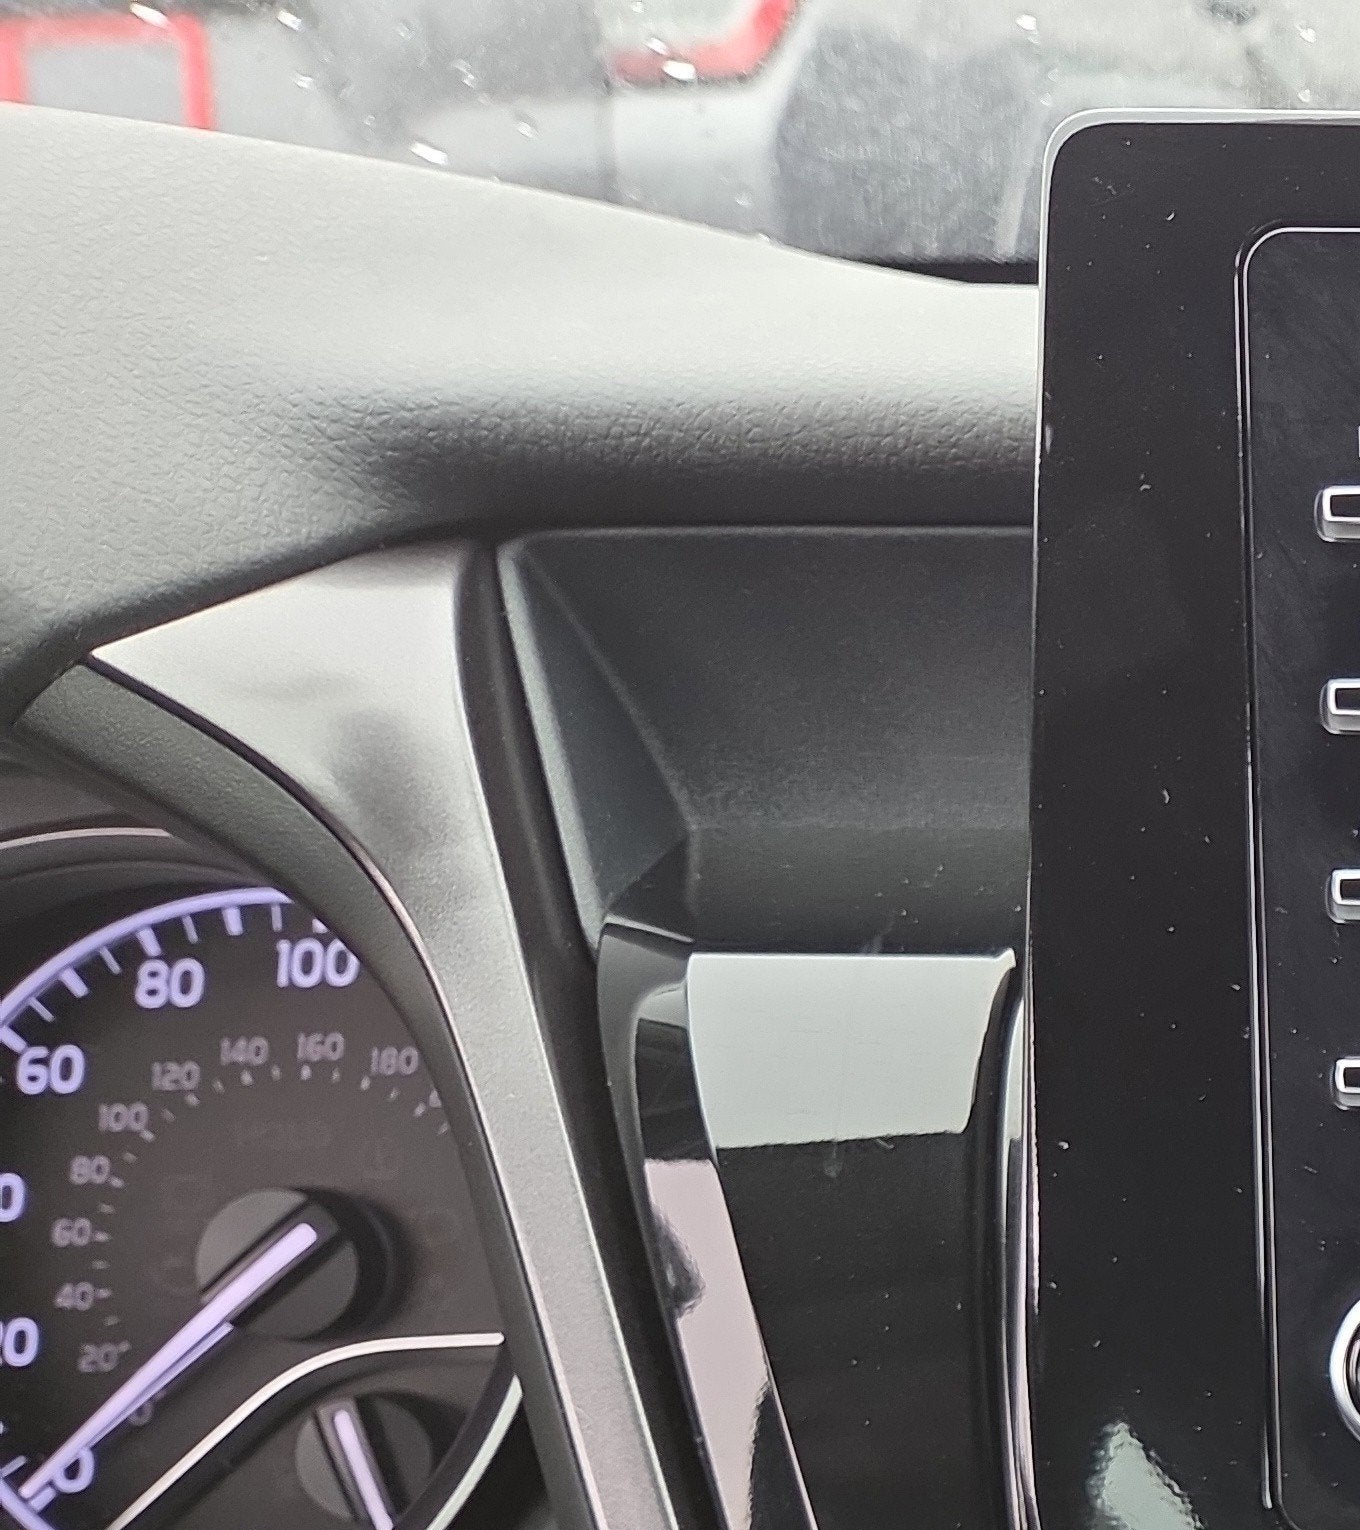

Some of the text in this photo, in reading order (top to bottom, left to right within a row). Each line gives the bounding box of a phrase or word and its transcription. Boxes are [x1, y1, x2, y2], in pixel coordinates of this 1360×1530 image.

[276, 937, 360, 988] 100
[135, 957, 206, 1009] 80
[220, 1036, 269, 1065] 140
[16, 1044, 85, 1095] 60
[151, 1061, 201, 1091] 120
[100, 1103, 149, 1132] 100
[69, 1155, 111, 1184] 80
